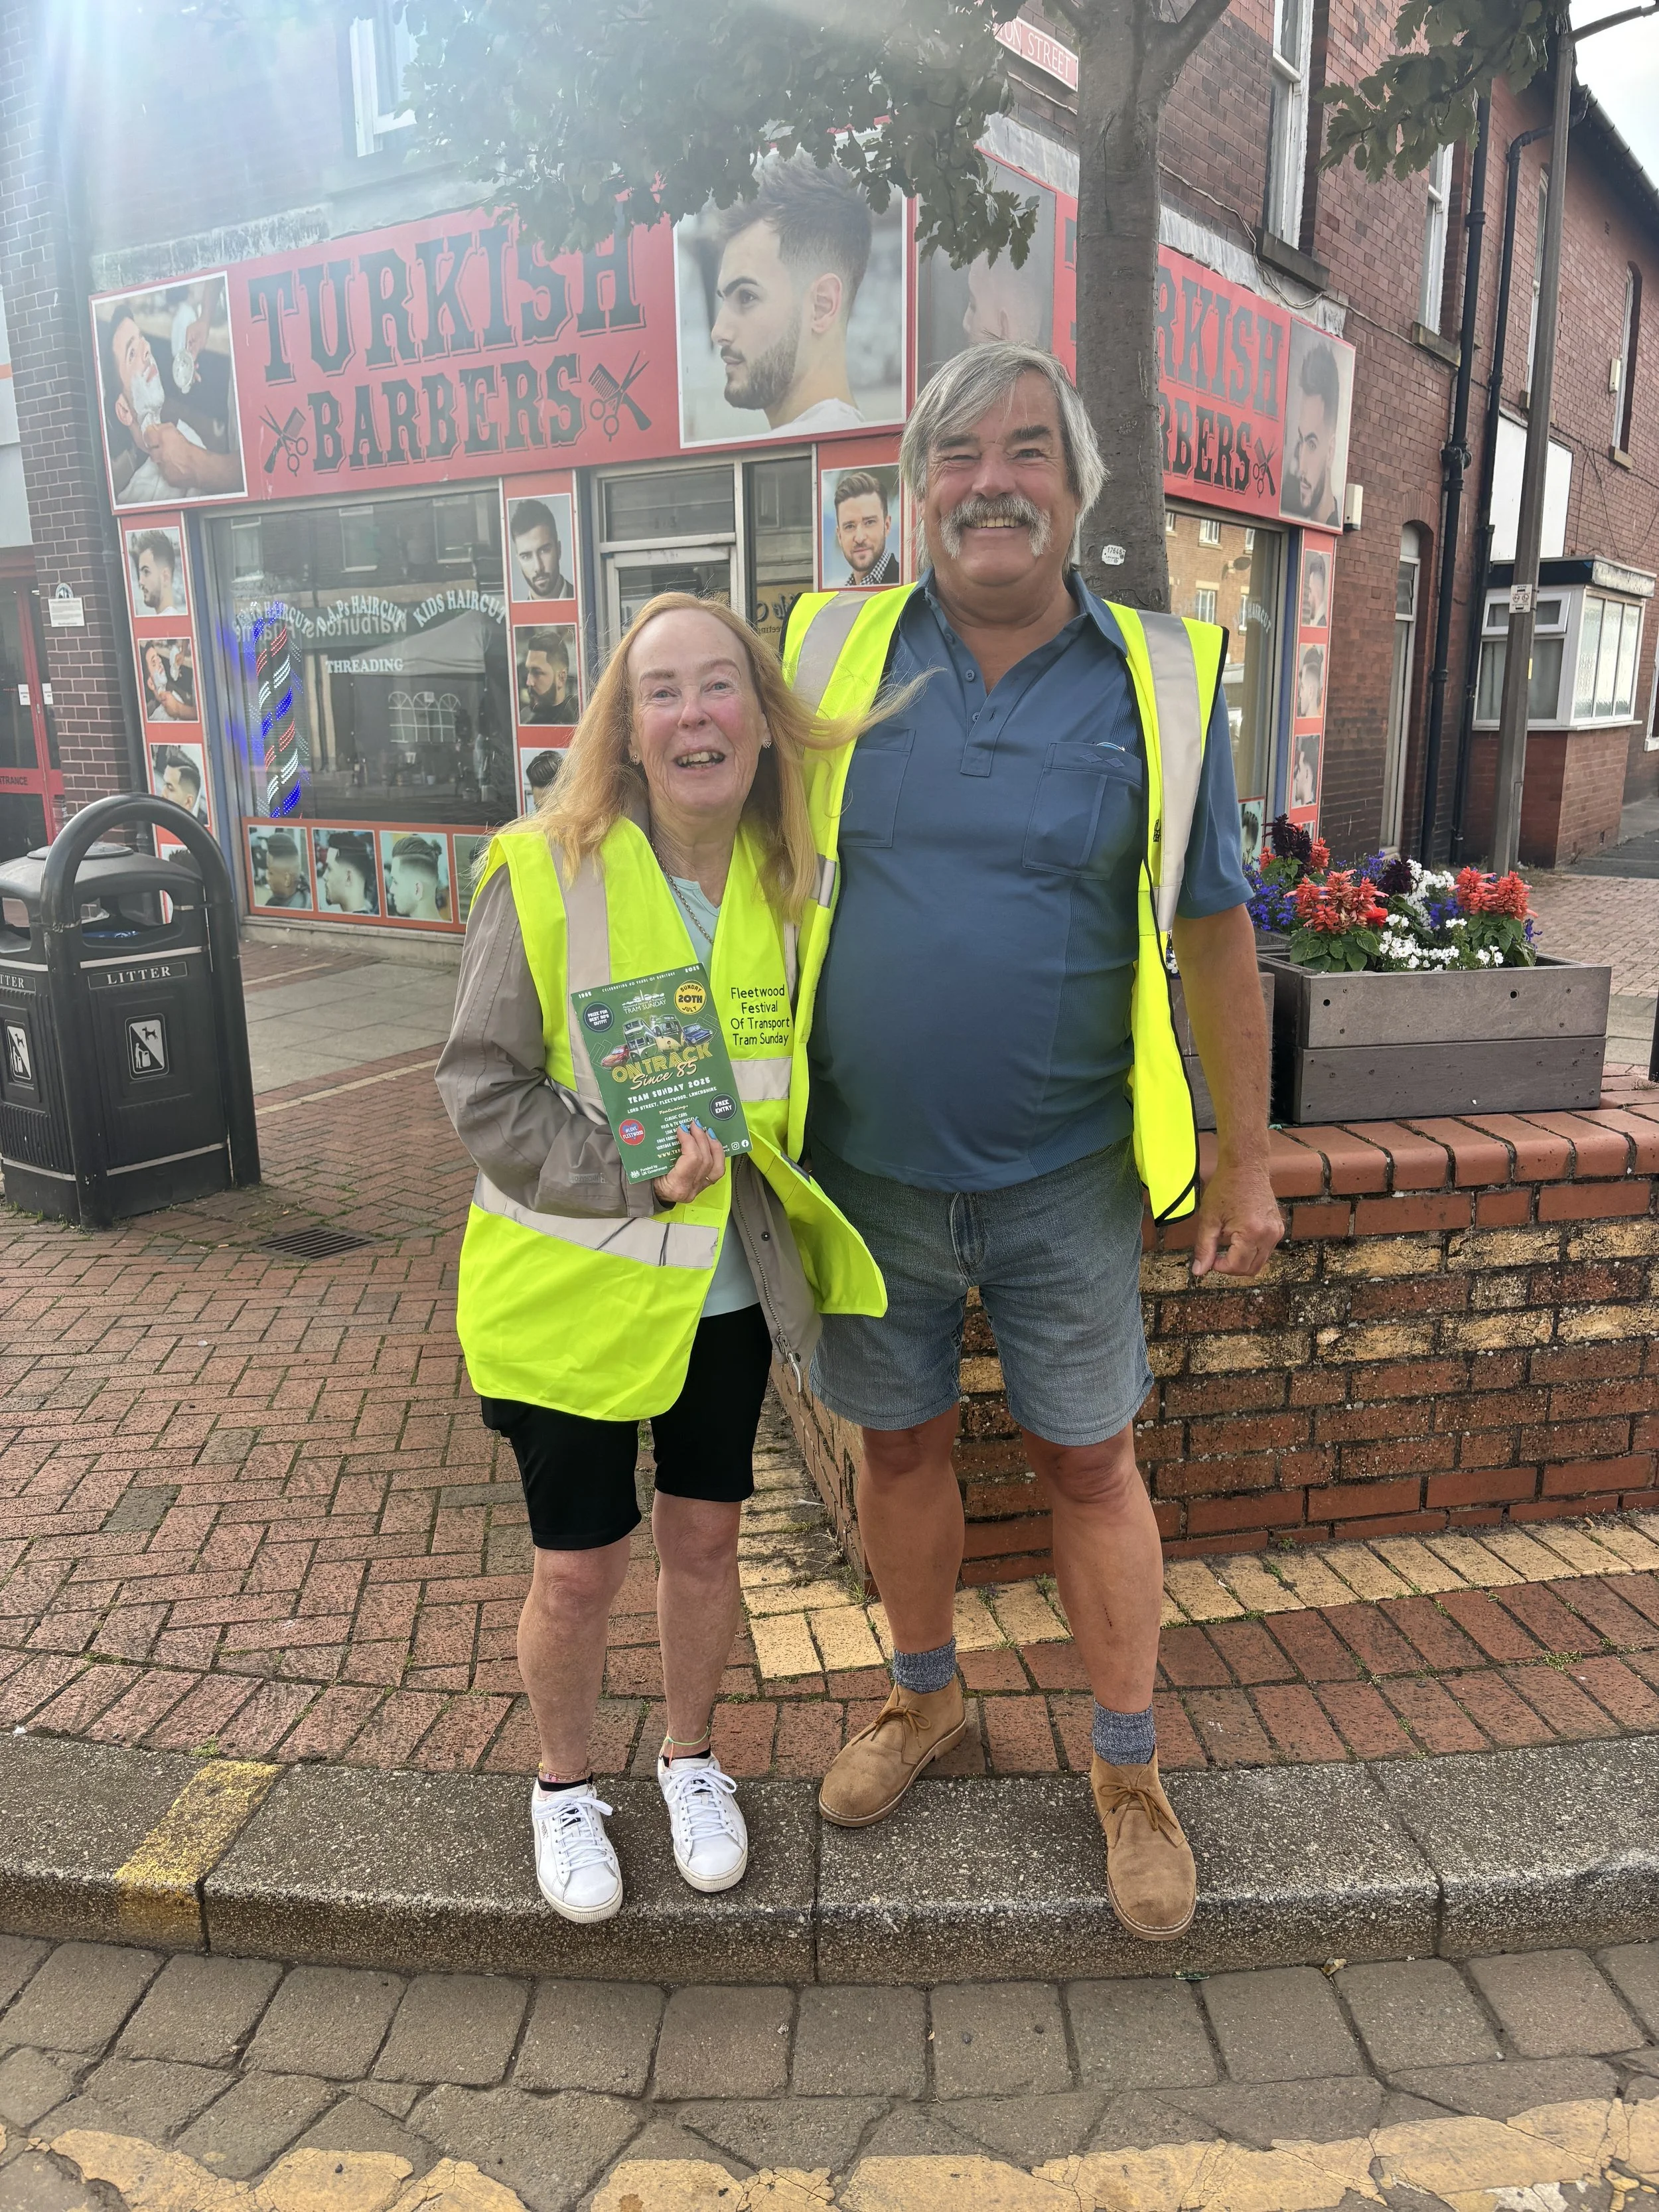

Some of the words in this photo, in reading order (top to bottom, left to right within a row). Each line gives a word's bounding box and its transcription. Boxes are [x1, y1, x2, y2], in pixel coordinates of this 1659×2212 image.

[1027, 31, 1071, 80] STREET
[248, 224, 646, 387] TURKISH
[1158, 265, 1285, 422] RKISH
[307, 352, 587, 475] BARBERS
[351, 595, 403, 629] HAIRCUT
[412, 593, 445, 628] KIDS
[446, 589, 506, 625] HAIRCUT
[325, 658, 403, 674] THREADING
[0, 775, 29, 786] TRANCE
[107, 966, 172, 985] LITTER
[678, 994, 703, 1003] 20TH
[731, 984, 785, 999] Fleetwood
[623, 1005, 642, 1014] TRAM
[642, 999, 666, 1010] SUNDAY
[741, 1000, 778, 1014] Festival
[730, 1018, 744, 1030] Of
[747, 1017, 790, 1031] Transport
[733, 1033, 757, 1046] Tram
[760, 1031, 789, 1047] Sunday
[630, 1071, 674, 1090] Since
[676, 1058, 698, 1078] 85
[628, 1092, 650, 1104] TRAM
[652, 1083, 684, 1098] SUNDAY
[688, 1076, 711, 1088] 2025
[715, 1099, 730, 1108] FREE
[715, 1104, 733, 1114] ENTRY
[622, 1130, 644, 1140] FLEETWOOD
